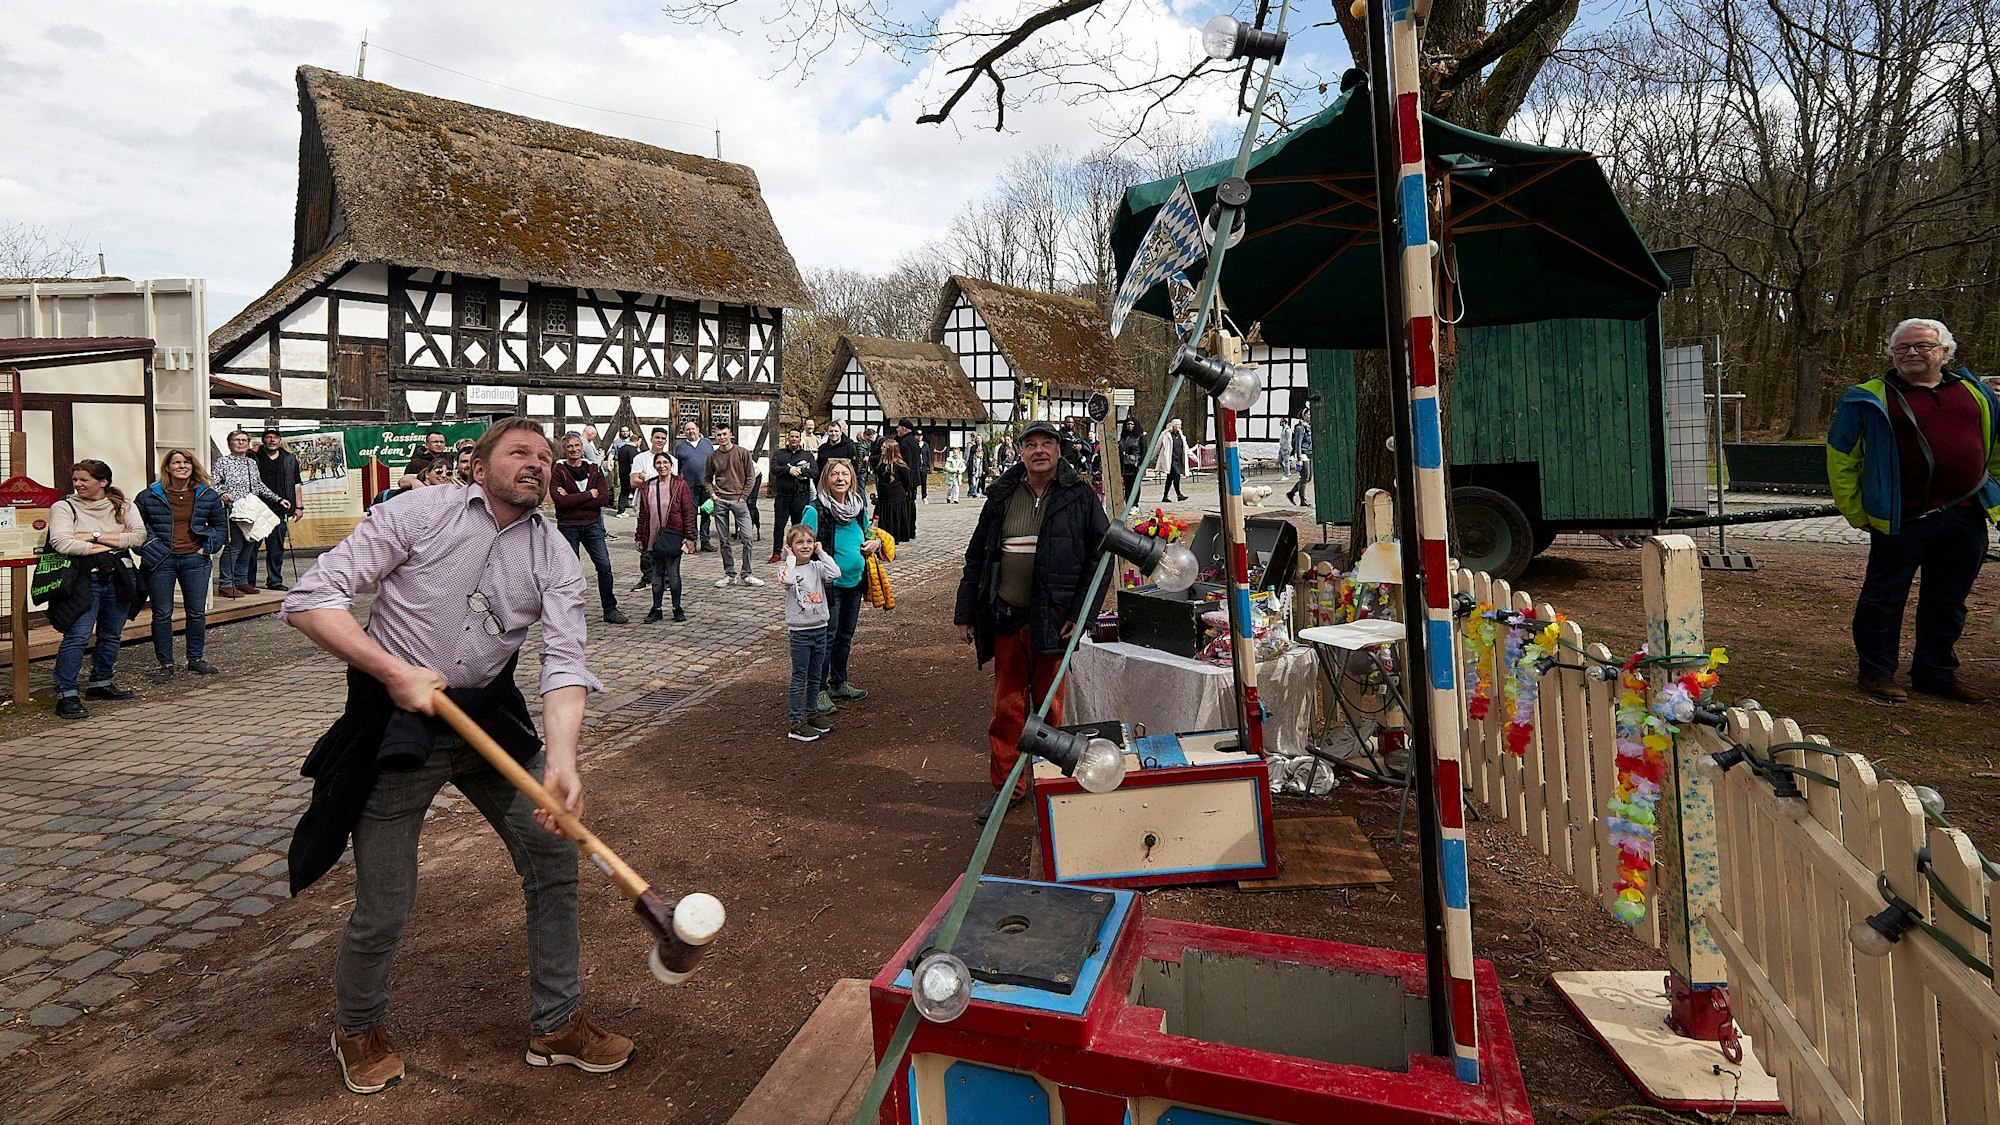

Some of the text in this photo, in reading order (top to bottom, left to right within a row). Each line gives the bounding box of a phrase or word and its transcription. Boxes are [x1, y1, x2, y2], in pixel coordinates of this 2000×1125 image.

[381, 431, 427, 443] Rassism
[359, 446, 380, 456] auf
[380, 447, 405, 457] dem
